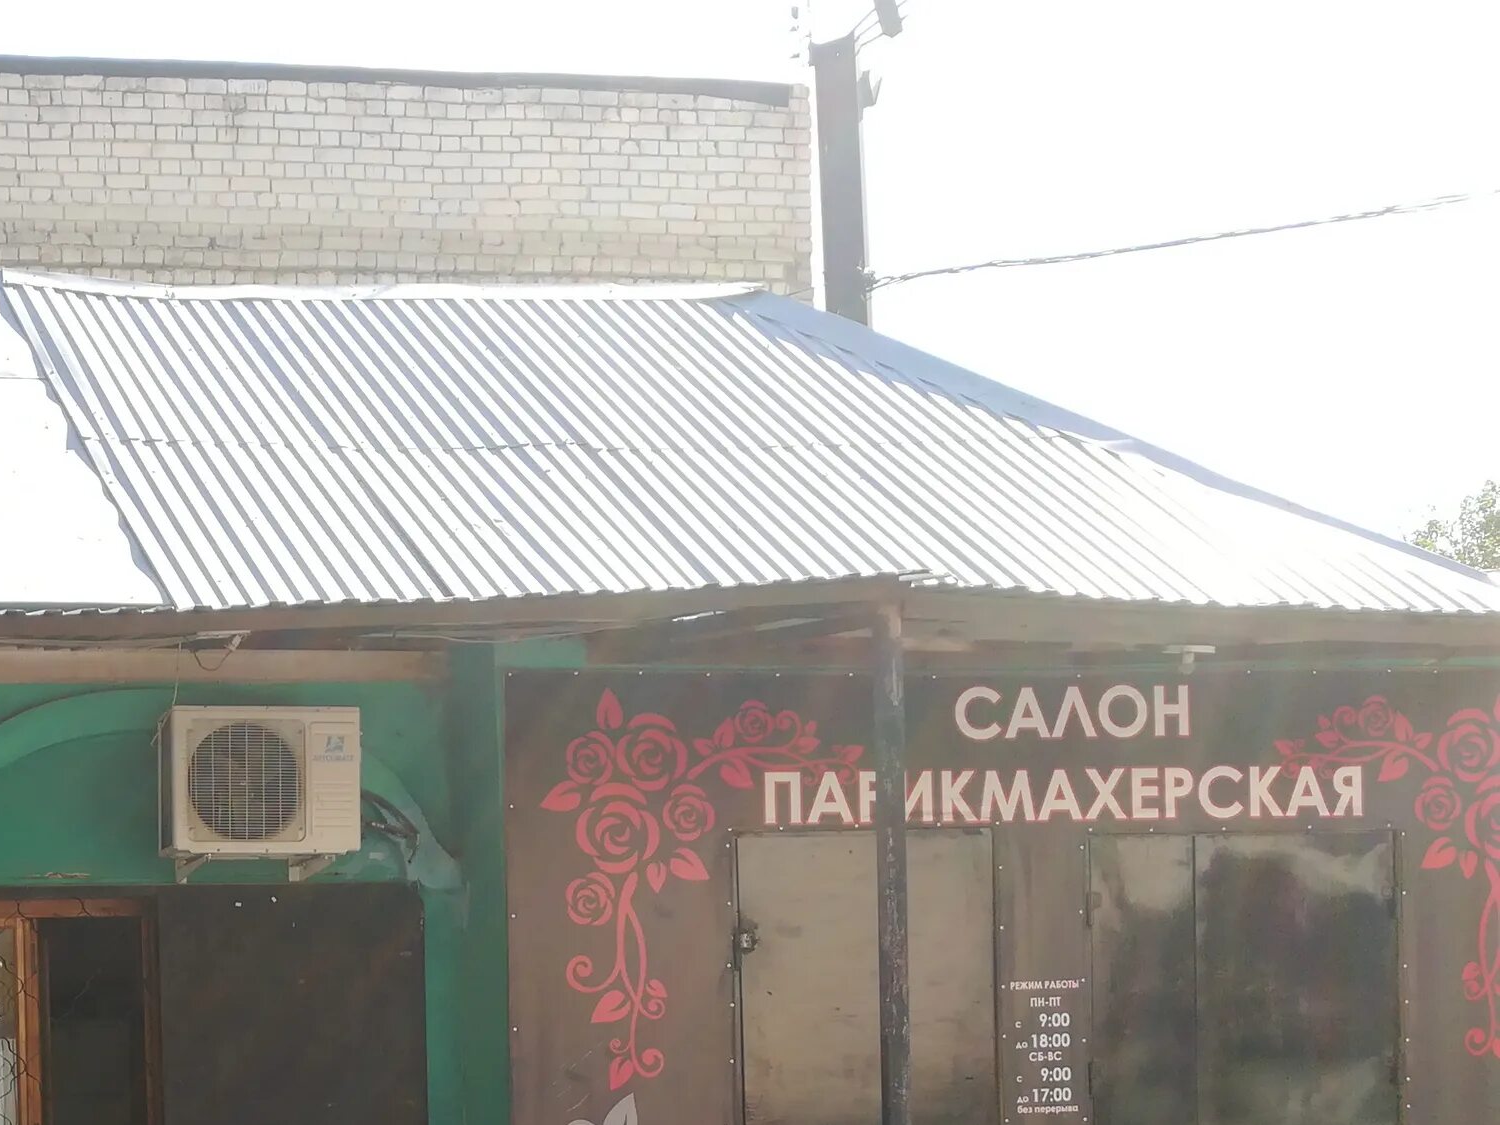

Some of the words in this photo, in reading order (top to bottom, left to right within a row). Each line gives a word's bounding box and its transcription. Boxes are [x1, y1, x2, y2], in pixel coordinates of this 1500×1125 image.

[955, 684, 1190, 740] САЛОН
[1010, 981, 1043, 990] РЕЖИМ
[1044, 980, 1079, 989] РАБОТЫ
[1030, 996, 1061, 1007] ПН-ПТ
[1039, 1012, 1070, 1027] 9:00
[1031, 1033, 1071, 1048] 18:00
[1029, 1051, 1062, 1061] СБ-ВС
[1041, 1067, 1072, 1082] 9:00
[1032, 1087, 1072, 1102] 17:00
[1017, 1105, 1033, 1114] без
[1034, 1105, 1079, 1114] перерыва
